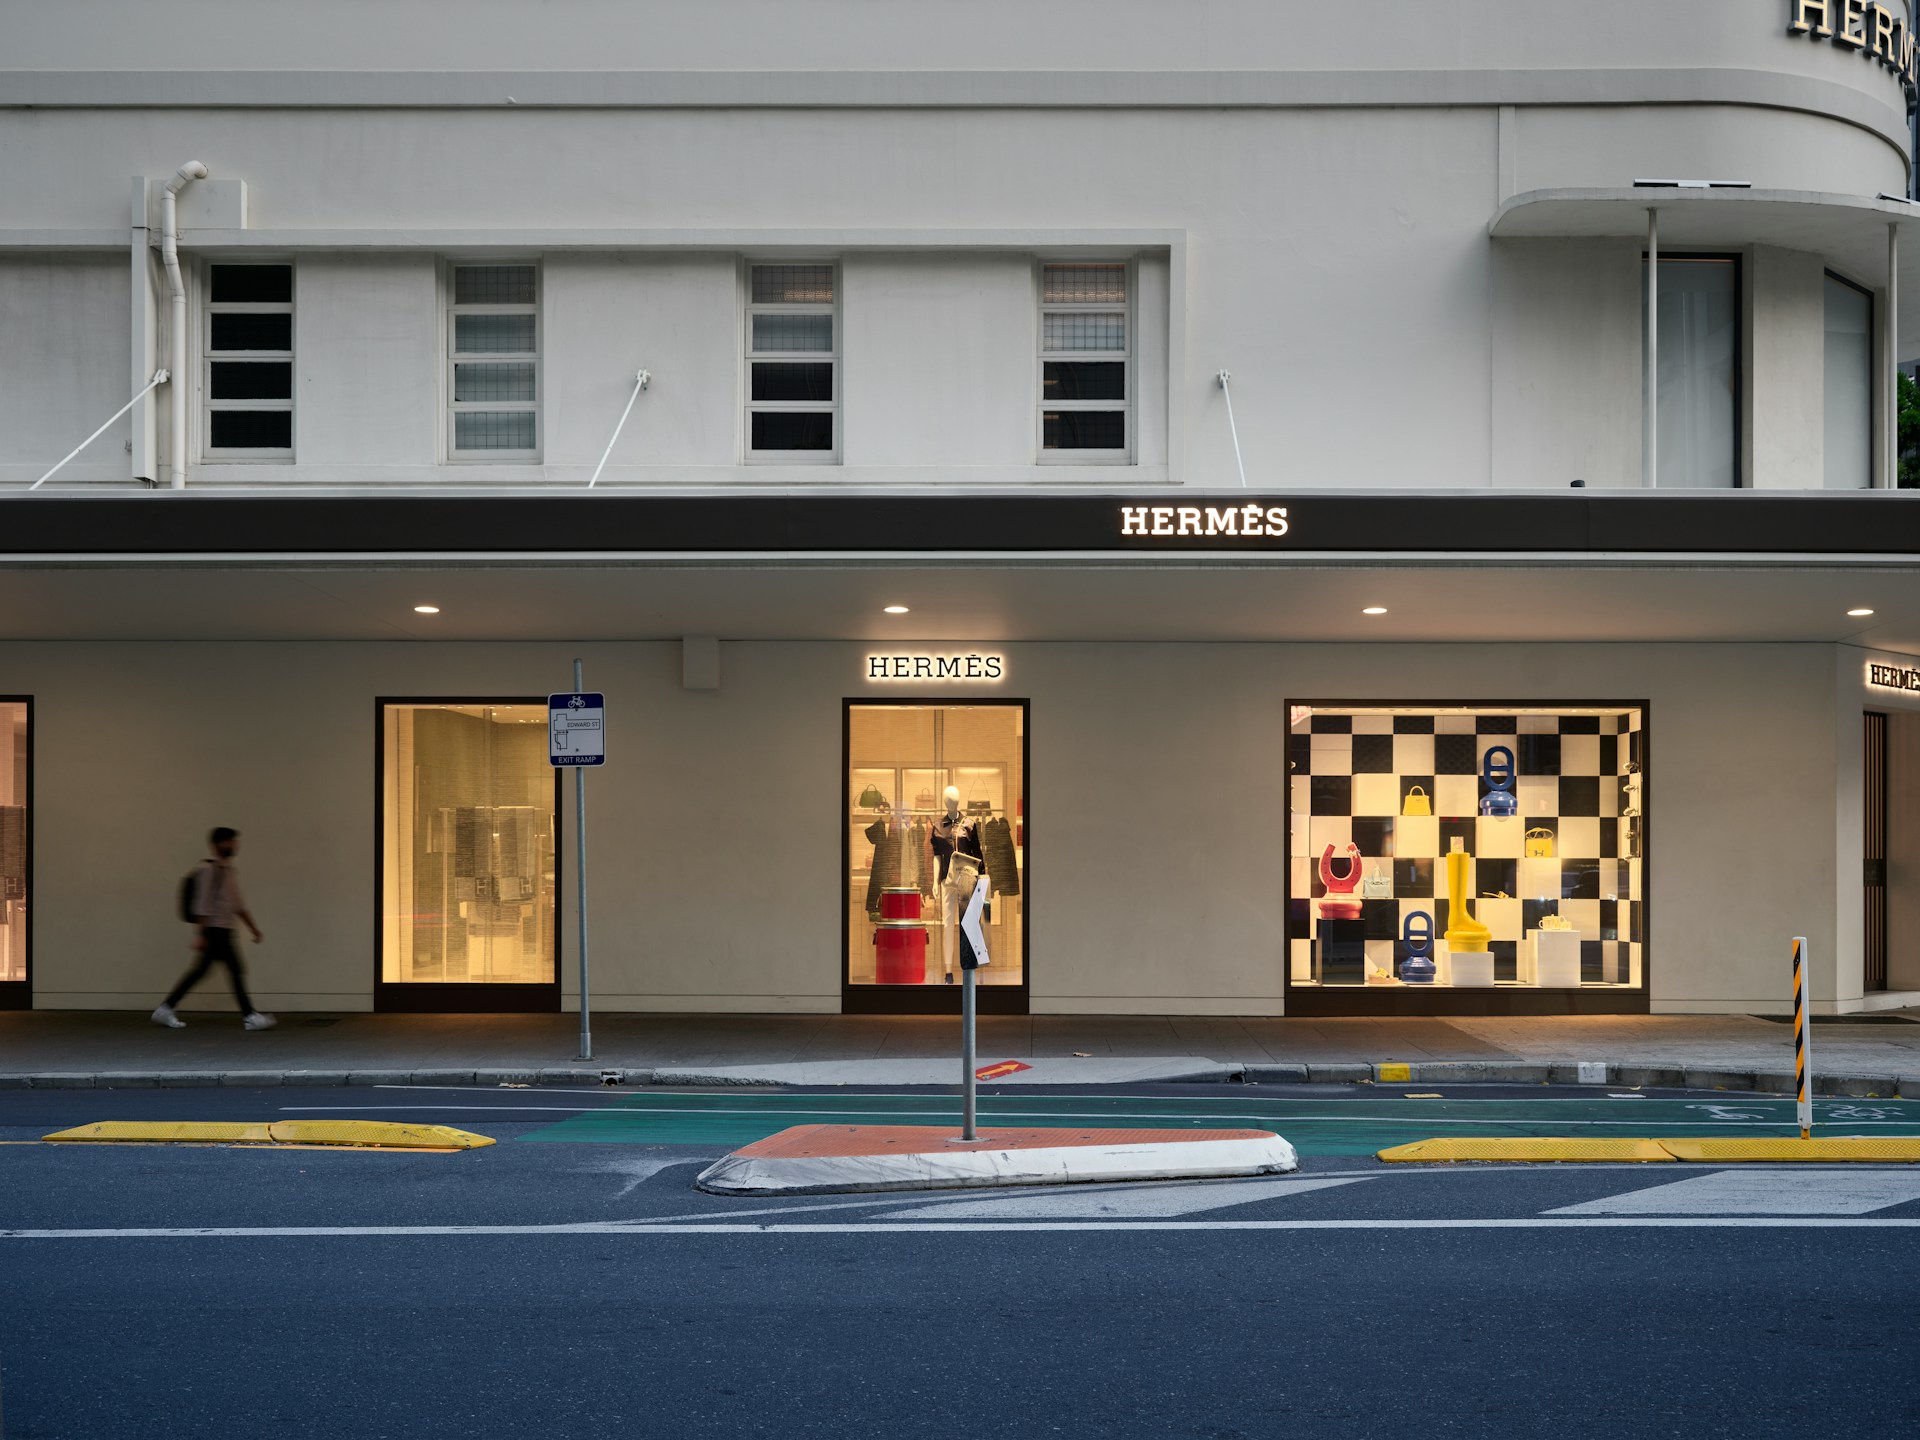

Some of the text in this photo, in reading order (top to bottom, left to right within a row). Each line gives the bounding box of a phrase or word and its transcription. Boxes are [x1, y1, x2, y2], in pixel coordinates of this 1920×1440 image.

[1788, 0, 1917, 85] HERM
[1870, 664, 1920, 691] HERMÈ
[6, 878, 17, 893] H
[476, 879, 487, 895] H
[520, 878, 533, 894] H
